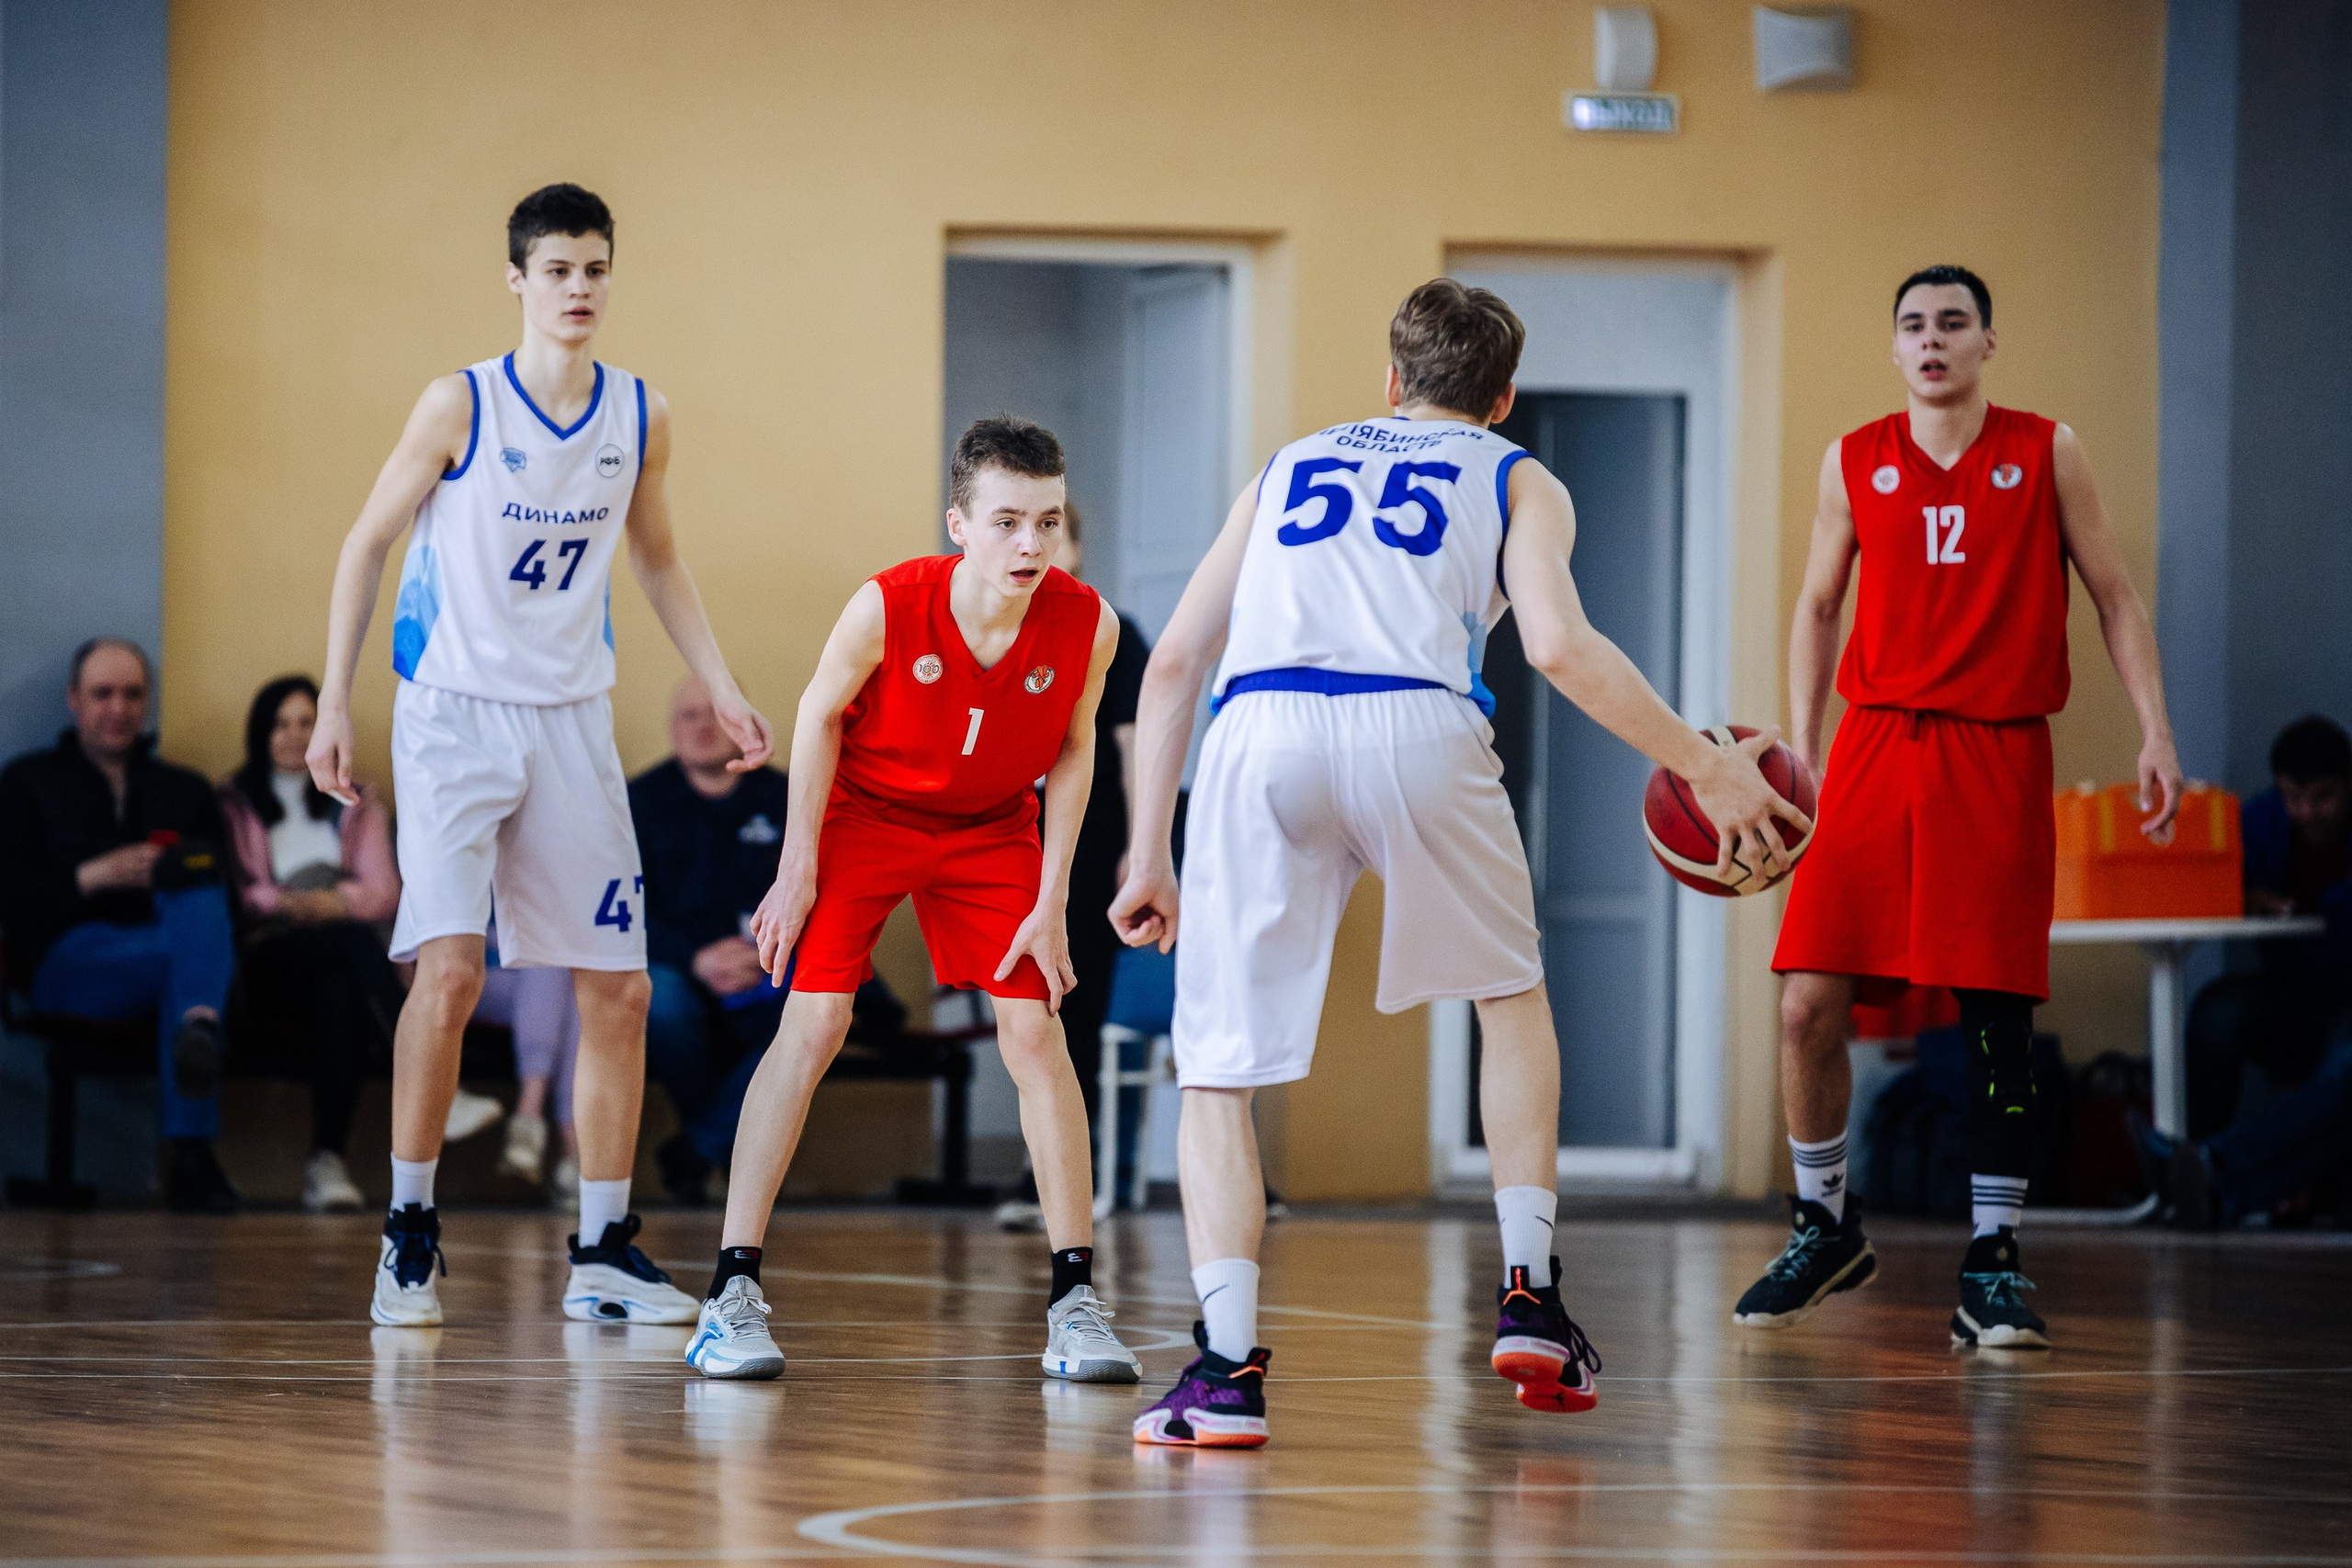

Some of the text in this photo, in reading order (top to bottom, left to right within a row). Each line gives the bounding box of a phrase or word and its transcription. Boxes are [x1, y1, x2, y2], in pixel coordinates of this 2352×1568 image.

[502, 502, 609, 525] ДИНАМО
[1278, 457, 1462, 557] 55
[1922, 504, 1966, 566] 12
[509, 537, 590, 591] 47
[961, 707, 985, 756] 1
